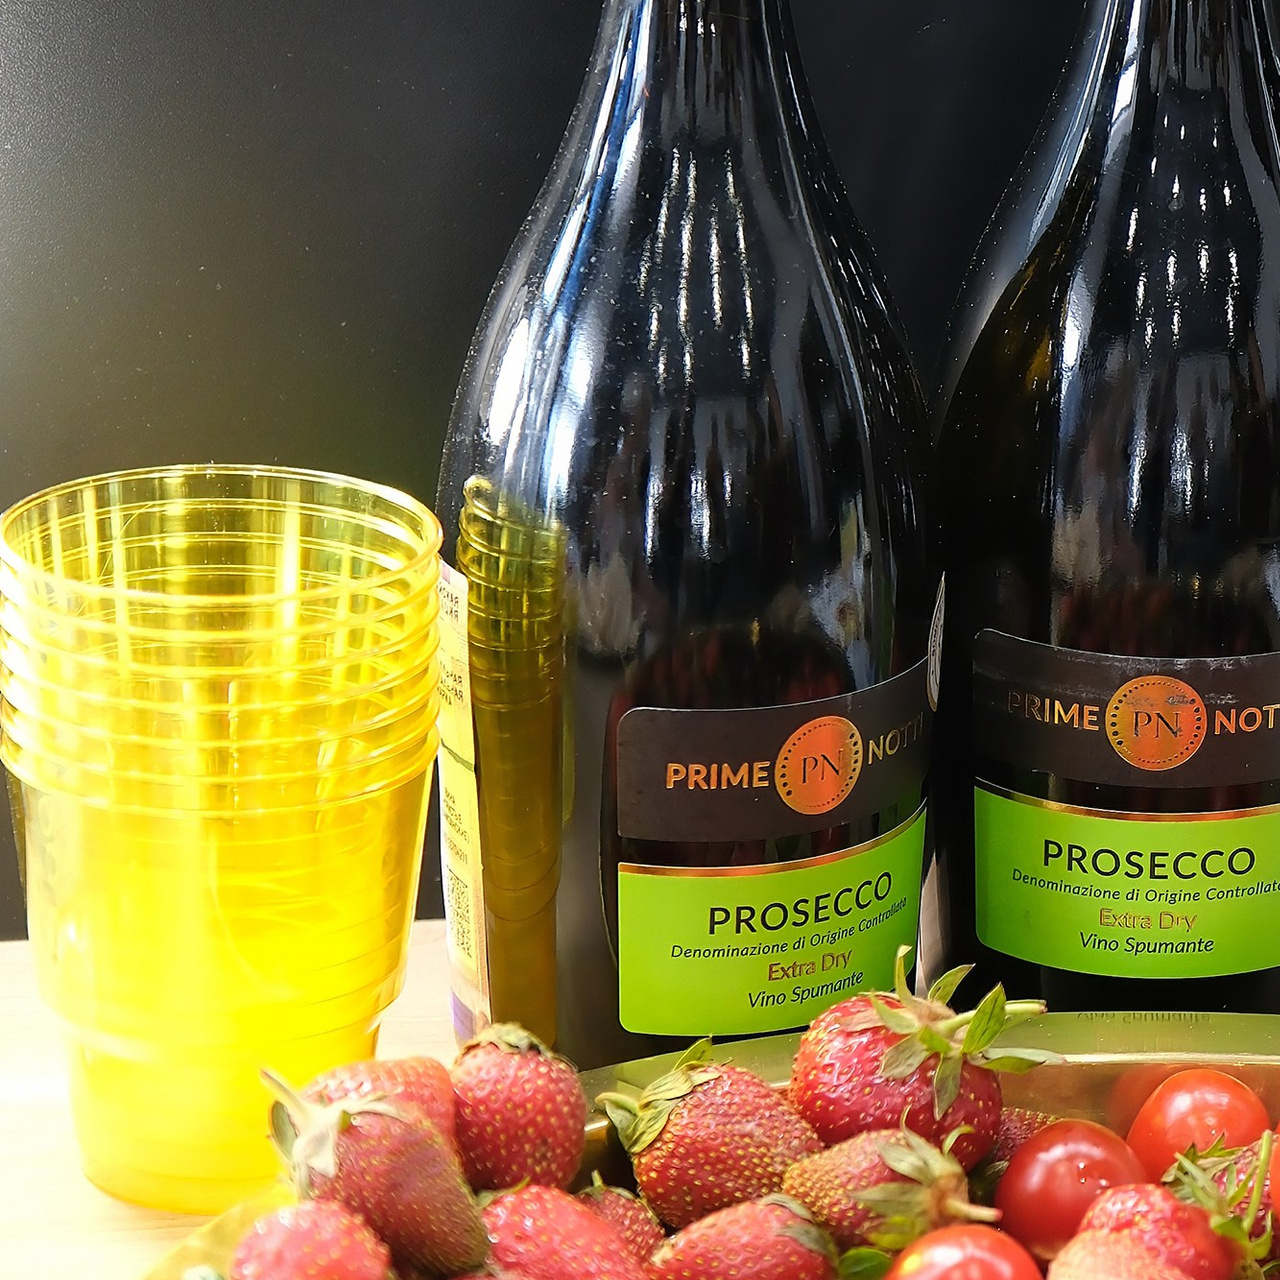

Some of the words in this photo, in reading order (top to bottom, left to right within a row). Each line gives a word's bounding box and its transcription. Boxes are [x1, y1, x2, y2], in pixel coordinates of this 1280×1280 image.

[1006, 690, 1101, 731] PRIME
[1132, 709, 1182, 740] PN
[665, 760, 771, 790] PRIME
[800, 748, 844, 784] PN
[867, 711, 924, 765] NOTTI
[1043, 838, 1256, 880] PROSECCO
[708, 871, 892, 935] PROSECCO
[1011, 868, 1121, 901] Denominazione
[1126, 888, 1139, 901] di
[1145, 889, 1201, 905] Origine
[671, 940, 788, 958] Denominazione
[792, 936, 805, 950] di
[810, 924, 855, 947] Origine
[858, 896, 907, 932] Controllata
[1099, 907, 1152, 930] Extra
[1159, 910, 1197, 933] Dry
[1079, 931, 1119, 952] Vino
[1123, 936, 1215, 956] Spumante
[767, 957, 817, 982] Extra
[821, 949, 853, 972] Dry
[748, 989, 786, 1008] Vino
[790, 970, 864, 1004] Spumante
